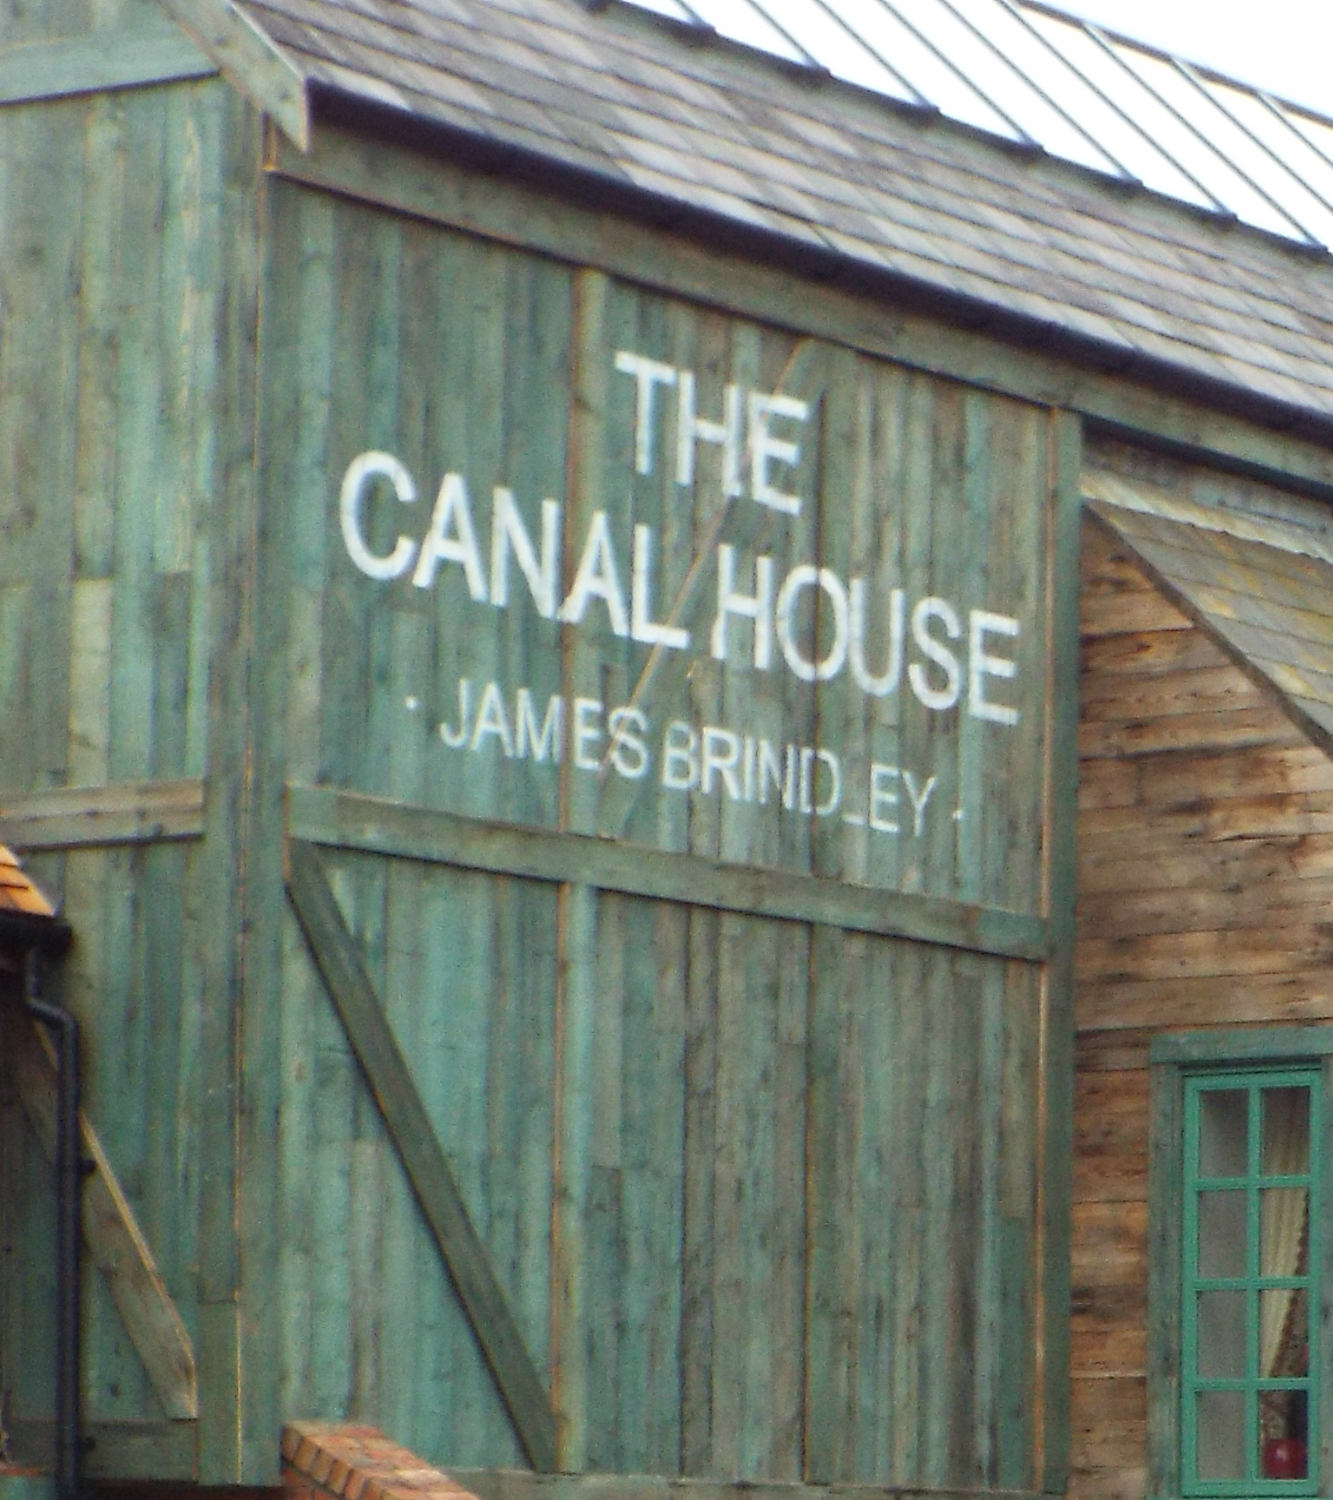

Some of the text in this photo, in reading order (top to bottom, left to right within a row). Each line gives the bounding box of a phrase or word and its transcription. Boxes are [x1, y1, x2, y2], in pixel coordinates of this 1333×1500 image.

[614, 350, 810, 517] THE
[339, 449, 1021, 726] CANAL HOUSE
[439, 678, 650, 780] JAMES
